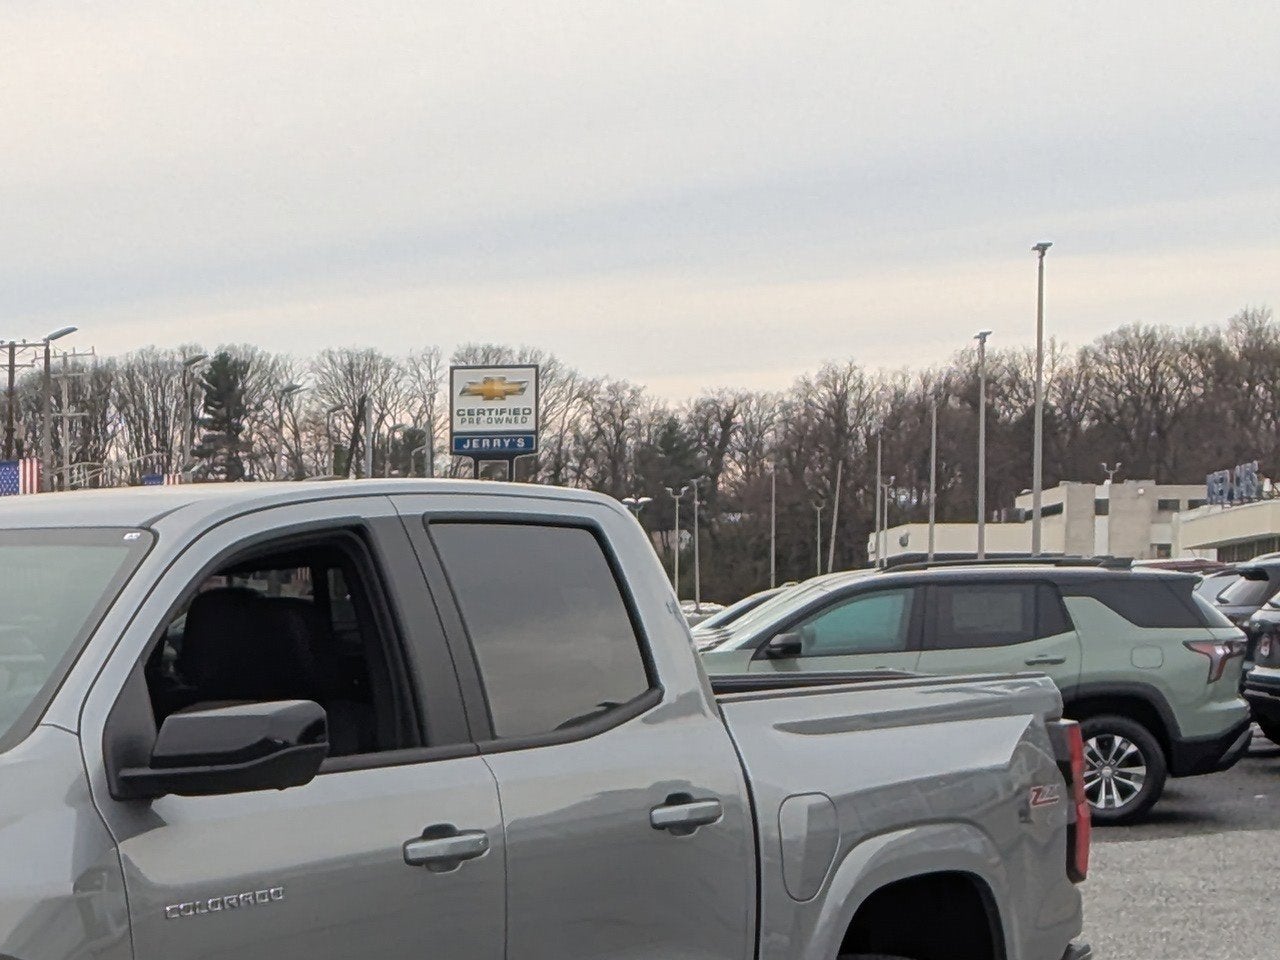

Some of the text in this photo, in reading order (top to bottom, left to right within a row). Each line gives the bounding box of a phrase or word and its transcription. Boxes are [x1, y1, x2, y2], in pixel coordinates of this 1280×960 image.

[456, 408, 532, 416] CERTIFIED
[463, 438, 525, 449] JERRY'S
[165, 886, 283, 919] COLORADO
